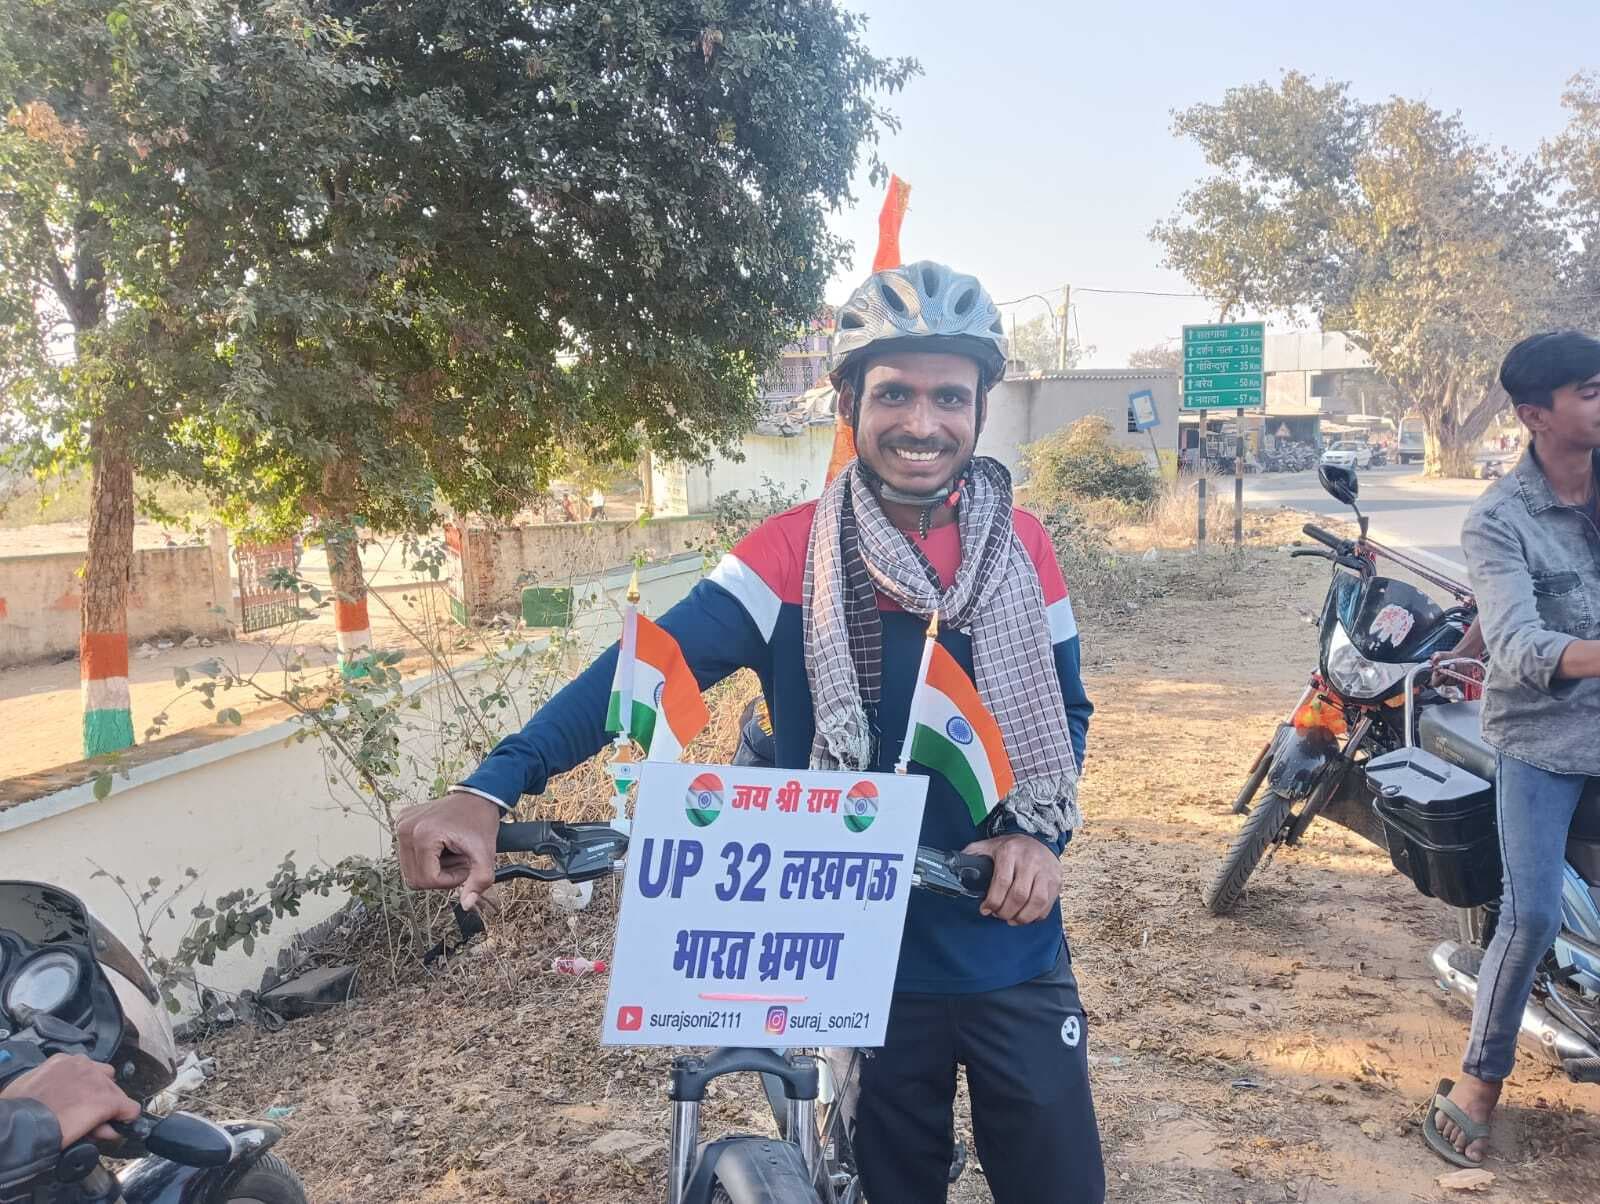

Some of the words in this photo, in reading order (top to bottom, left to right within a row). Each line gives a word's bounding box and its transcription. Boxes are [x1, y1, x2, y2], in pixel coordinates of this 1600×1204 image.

[731, 784, 772, 812] जय
[775, 780, 803, 813] श्री
[807, 788, 842, 814] राम
[639, 838, 704, 899] UP
[715, 841, 772, 902] 32
[779, 850, 904, 901] लखनऊ
[673, 929, 756, 980] भारत
[758, 931, 845, 982] भ्रमण
[649, 1009, 742, 1033] surajsoni2111
[789, 1010, 870, 1035] suraj_soni21
